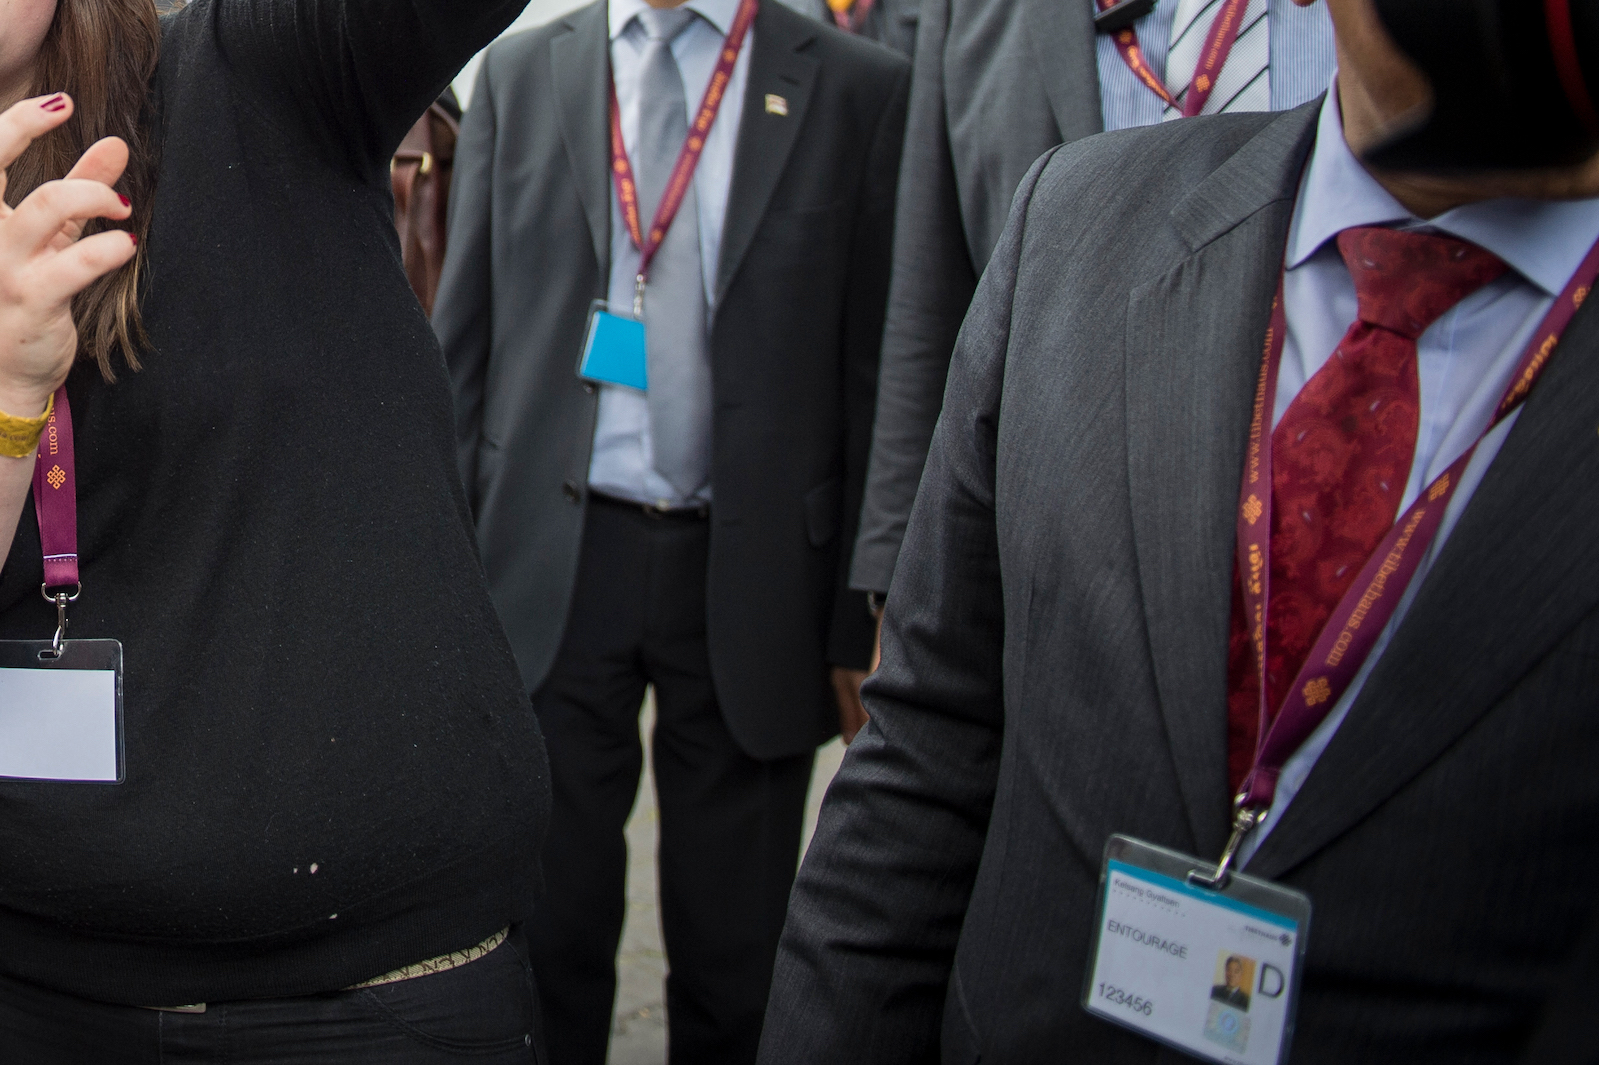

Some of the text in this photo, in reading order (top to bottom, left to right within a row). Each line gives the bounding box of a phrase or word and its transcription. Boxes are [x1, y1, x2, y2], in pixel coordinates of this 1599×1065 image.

[1325, 508, 1426, 667] www.tibethaus.com
[1106, 919, 1188, 960] ENTOURAGE
[1099, 982, 1153, 1016] 123456
[1258, 962, 1285, 999] D
